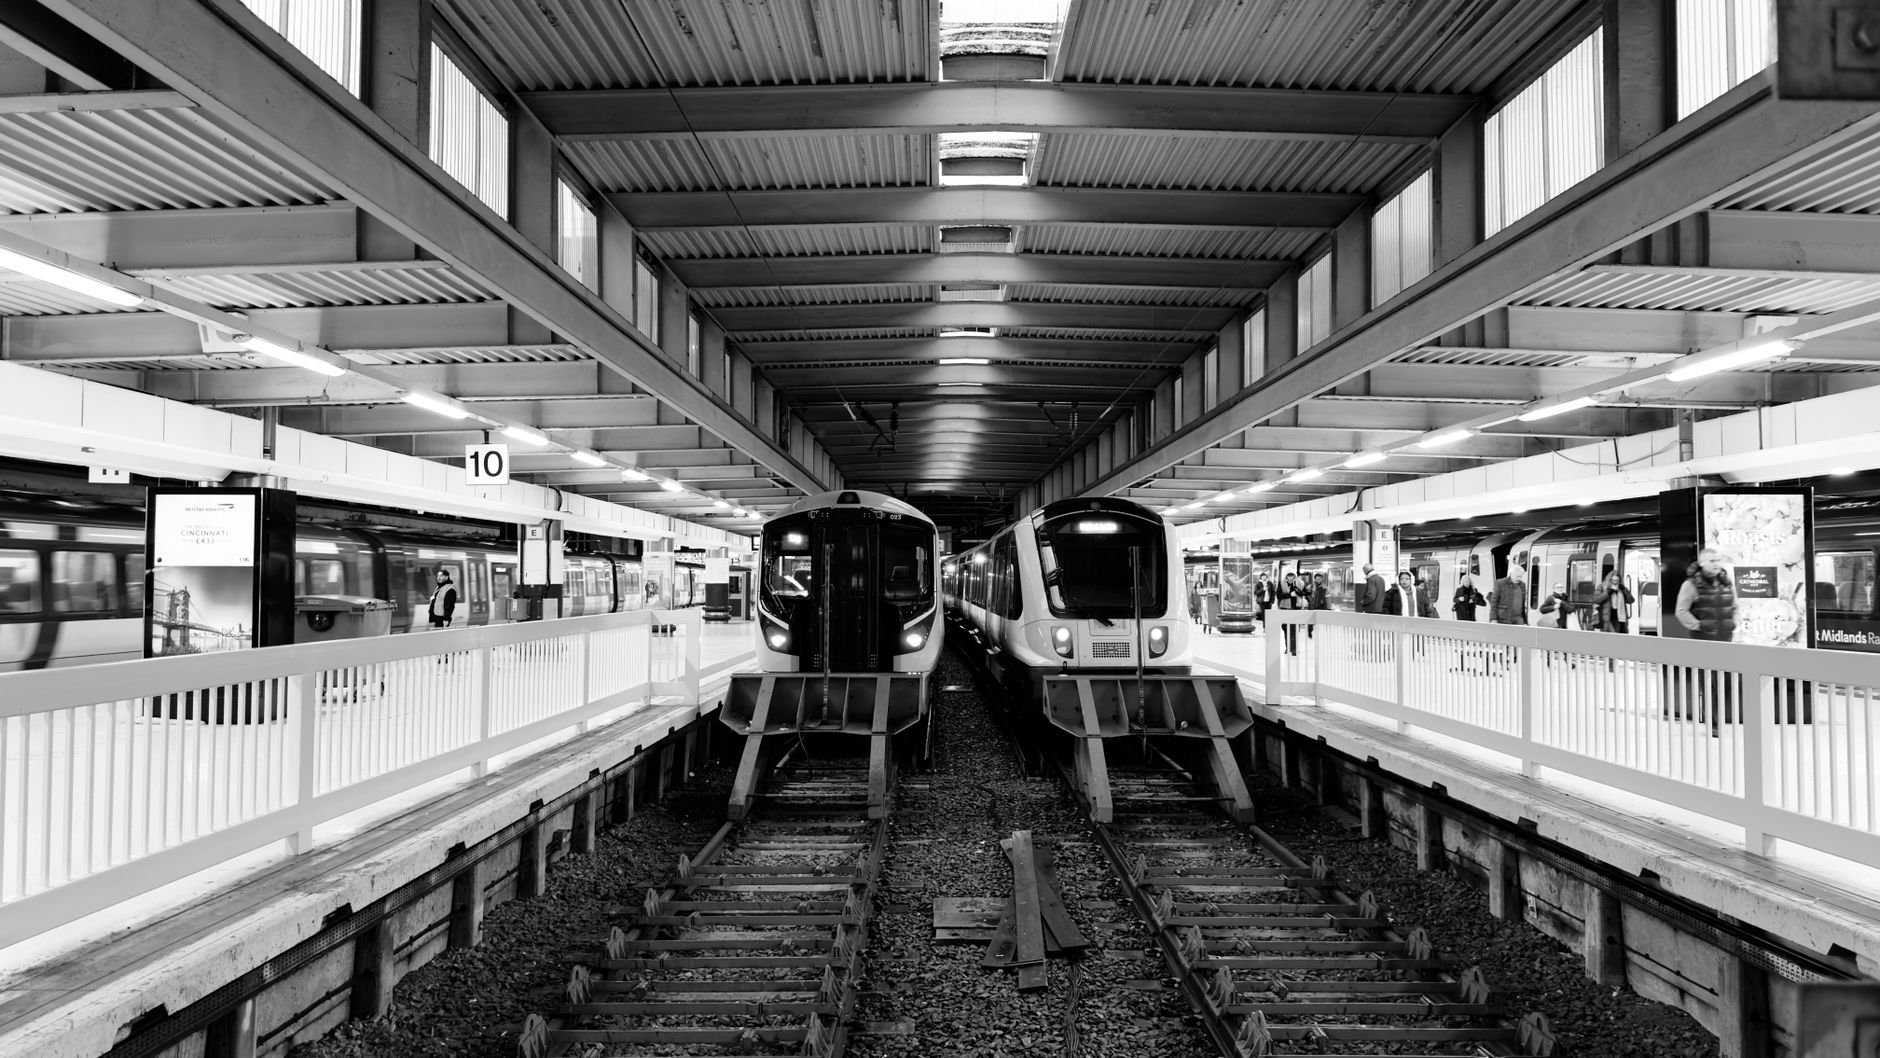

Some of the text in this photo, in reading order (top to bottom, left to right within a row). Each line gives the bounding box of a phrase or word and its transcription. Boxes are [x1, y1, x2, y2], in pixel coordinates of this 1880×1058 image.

[470, 450, 503, 477] 10
[531, 529, 537, 537] E
[1733, 618, 1785, 634] etter
[1821, 629, 1867, 645] Midlands
